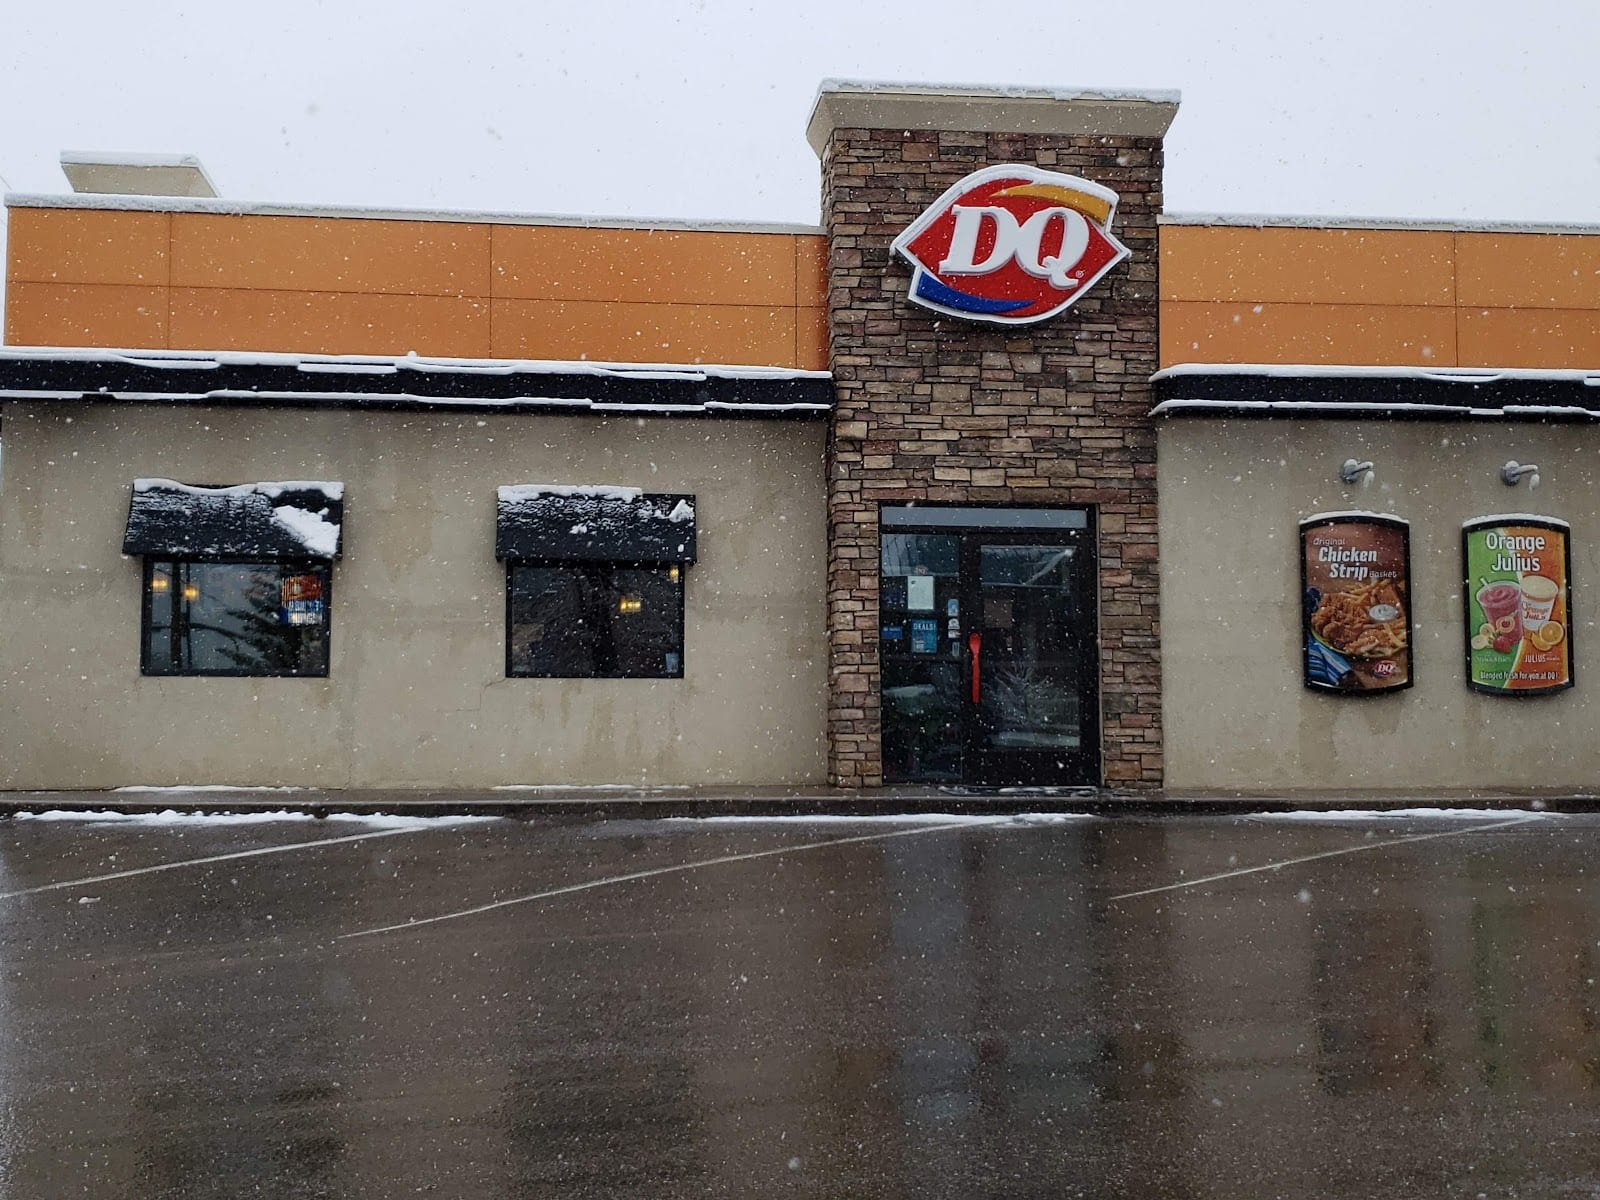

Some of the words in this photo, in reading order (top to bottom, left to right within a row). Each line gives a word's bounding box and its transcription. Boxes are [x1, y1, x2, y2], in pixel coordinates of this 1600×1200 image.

[938, 204, 1089, 290] DQ
[1313, 538, 1345, 546] Original
[1486, 532, 1545, 554] Orange
[1319, 547, 1377, 562] Chicken
[1329, 563, 1369, 581] Strip
[1369, 570, 1397, 578] Basket
[1491, 555, 1541, 572] Julius
[1525, 653, 1546, 663] JULIUS
